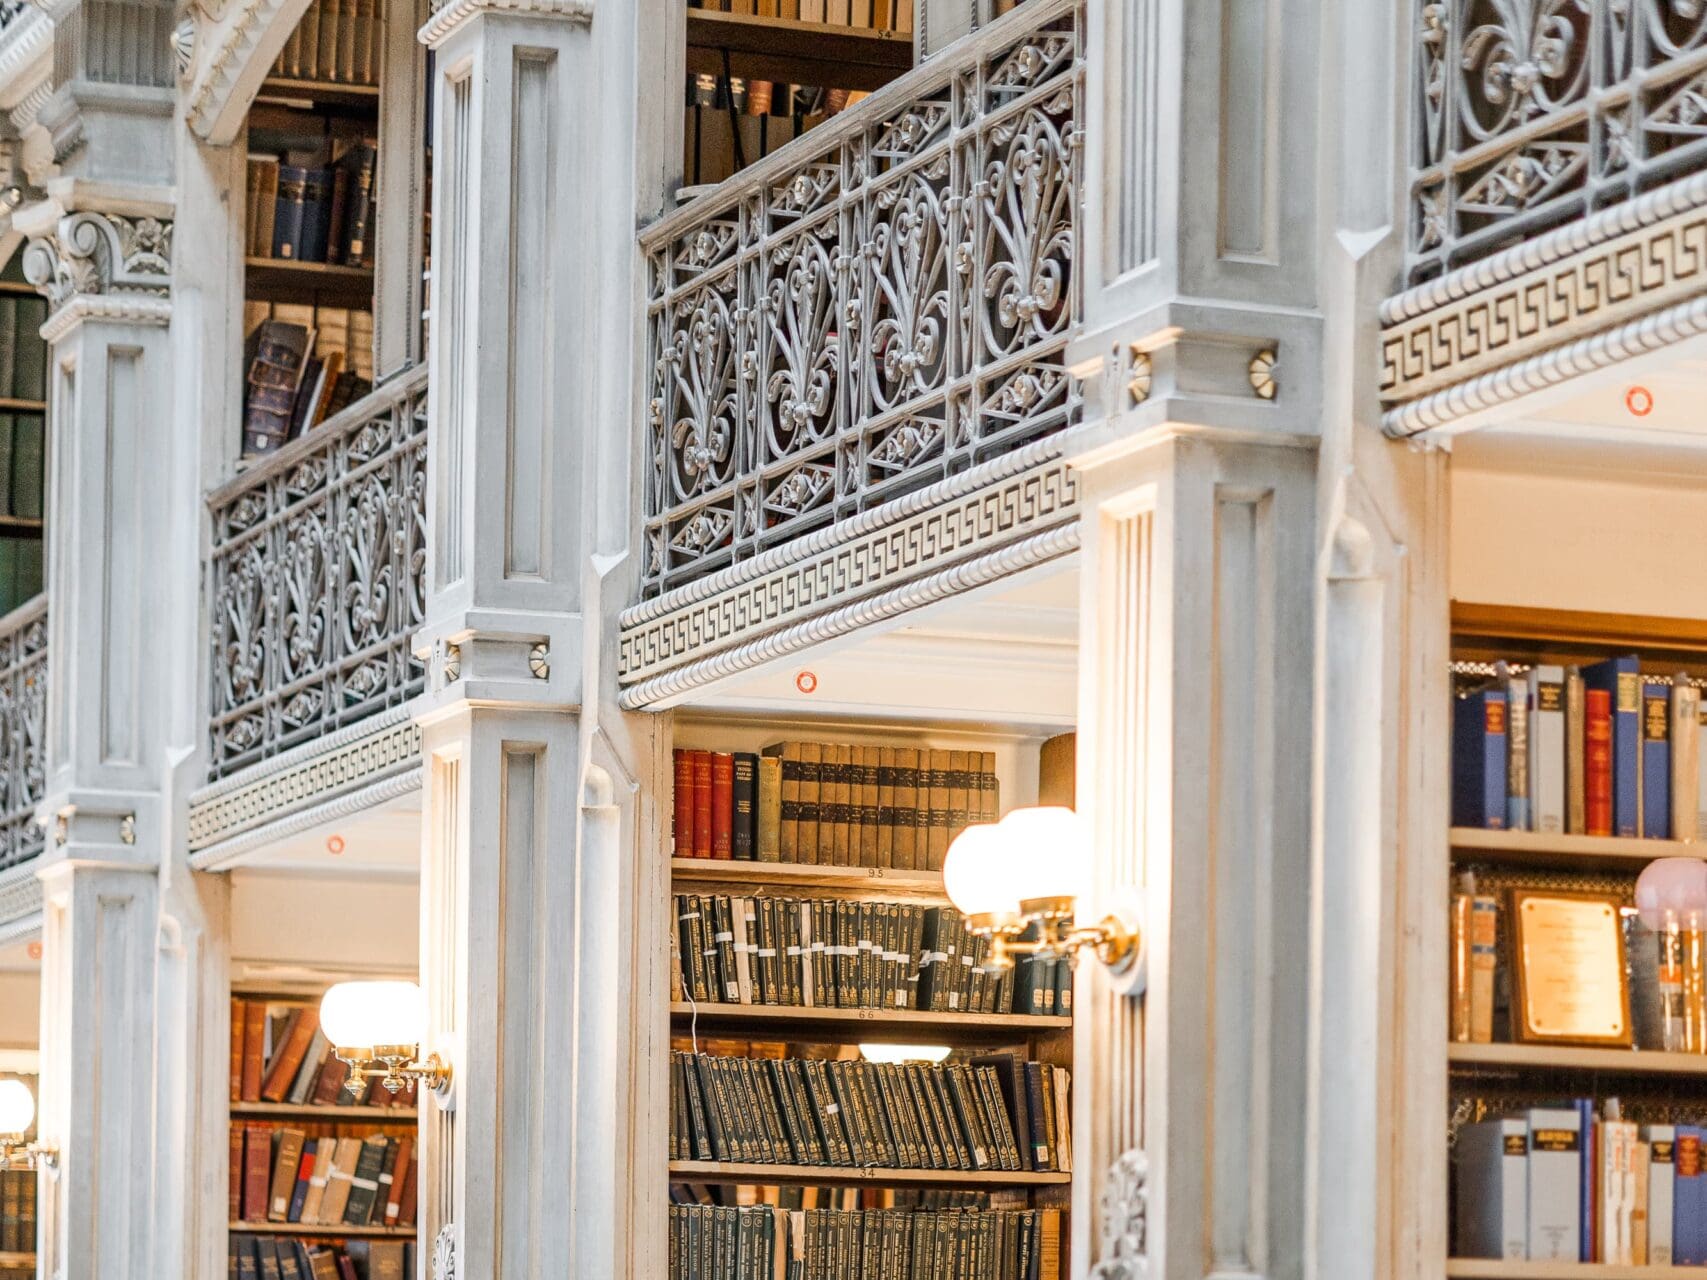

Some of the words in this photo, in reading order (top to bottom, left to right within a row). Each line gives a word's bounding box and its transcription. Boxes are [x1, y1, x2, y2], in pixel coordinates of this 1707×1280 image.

[868, 868, 884, 878] 95
[859, 1010, 874, 1019] 66
[860, 1168, 876, 1179] 34
